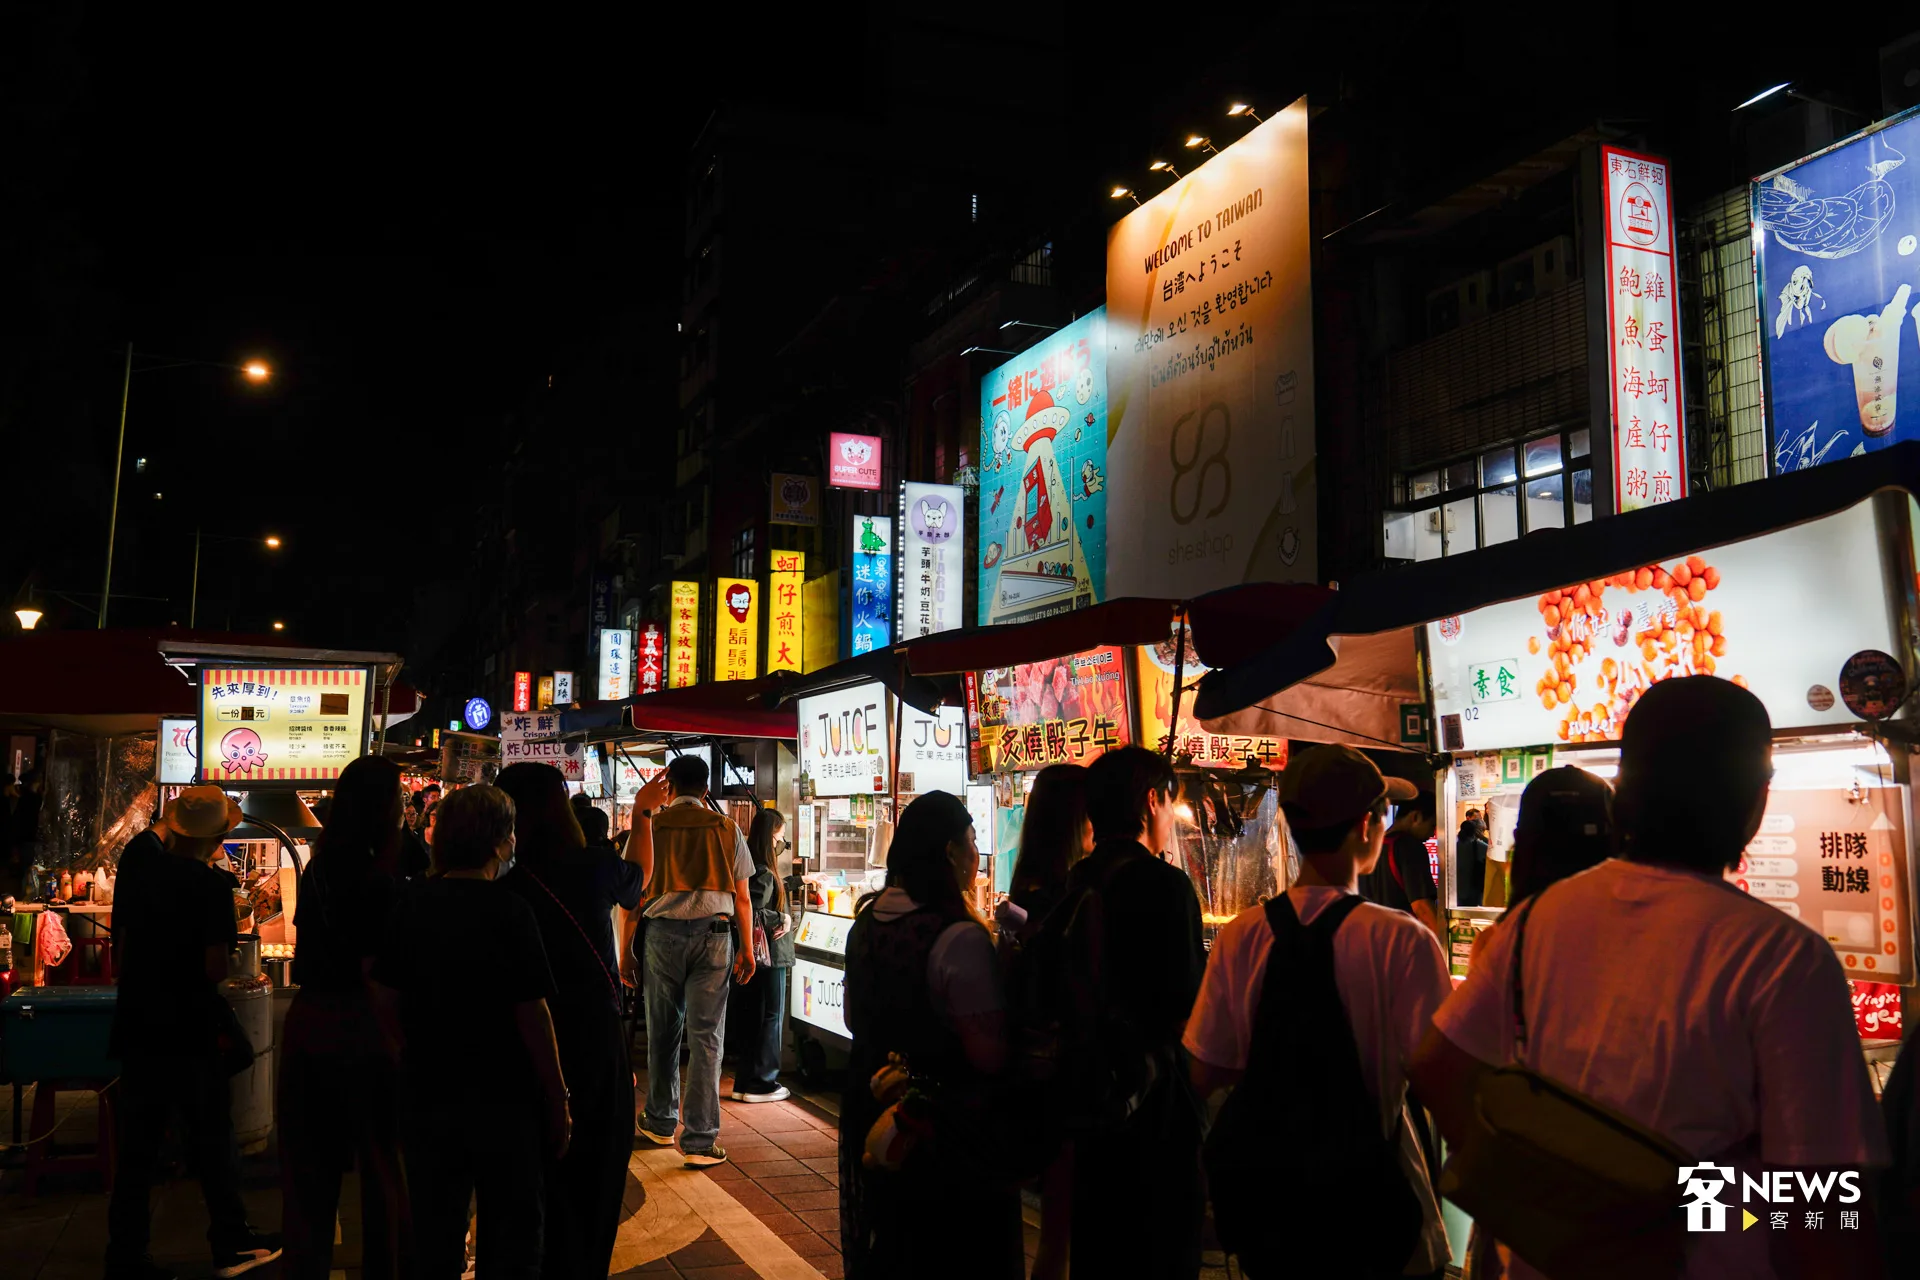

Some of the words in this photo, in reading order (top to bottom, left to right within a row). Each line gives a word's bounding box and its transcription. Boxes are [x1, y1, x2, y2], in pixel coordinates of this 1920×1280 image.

[1610, 157, 1664, 186] 東石鮮蚵
[1144, 229, 1194, 275] WELCOME
[1197, 219, 1212, 243] TO
[1215, 187, 1263, 232] TAIWAN
[1162, 239, 1242, 303] 台湾へようこそ
[1134, 327, 1164, 354] 대만에
[1166, 312, 1187, 340] 오신
[1190, 300, 1212, 329] 것을
[1215, 270, 1273, 315] 환영합니다
[1619, 264, 1649, 500] 鮑魚海產粥
[1643, 271, 1673, 502] 雞蛋蚵仔煎
[834, 465, 858, 474] SUPER
[858, 468, 877, 477] CUTE
[776, 555, 799, 666] 蚵仔煎大
[855, 563, 873, 653] 迷你火鍋
[212, 682, 278, 701] 先來厚到!
[1473, 666, 1516, 699] 素食
[514, 715, 554, 732] 炸鮮
[1464, 706, 1480, 721] 02
[1568, 714, 1617, 738] sweet
[523, 731, 548, 739] Crispy
[818, 703, 879, 759] JUICE
[1000, 716, 1120, 765] 炙燒骰子牛
[1157, 734, 1278, 764] 炙燒骰子牛
[1819, 831, 1868, 859] 排隊
[1821, 865, 1870, 894] 動線
